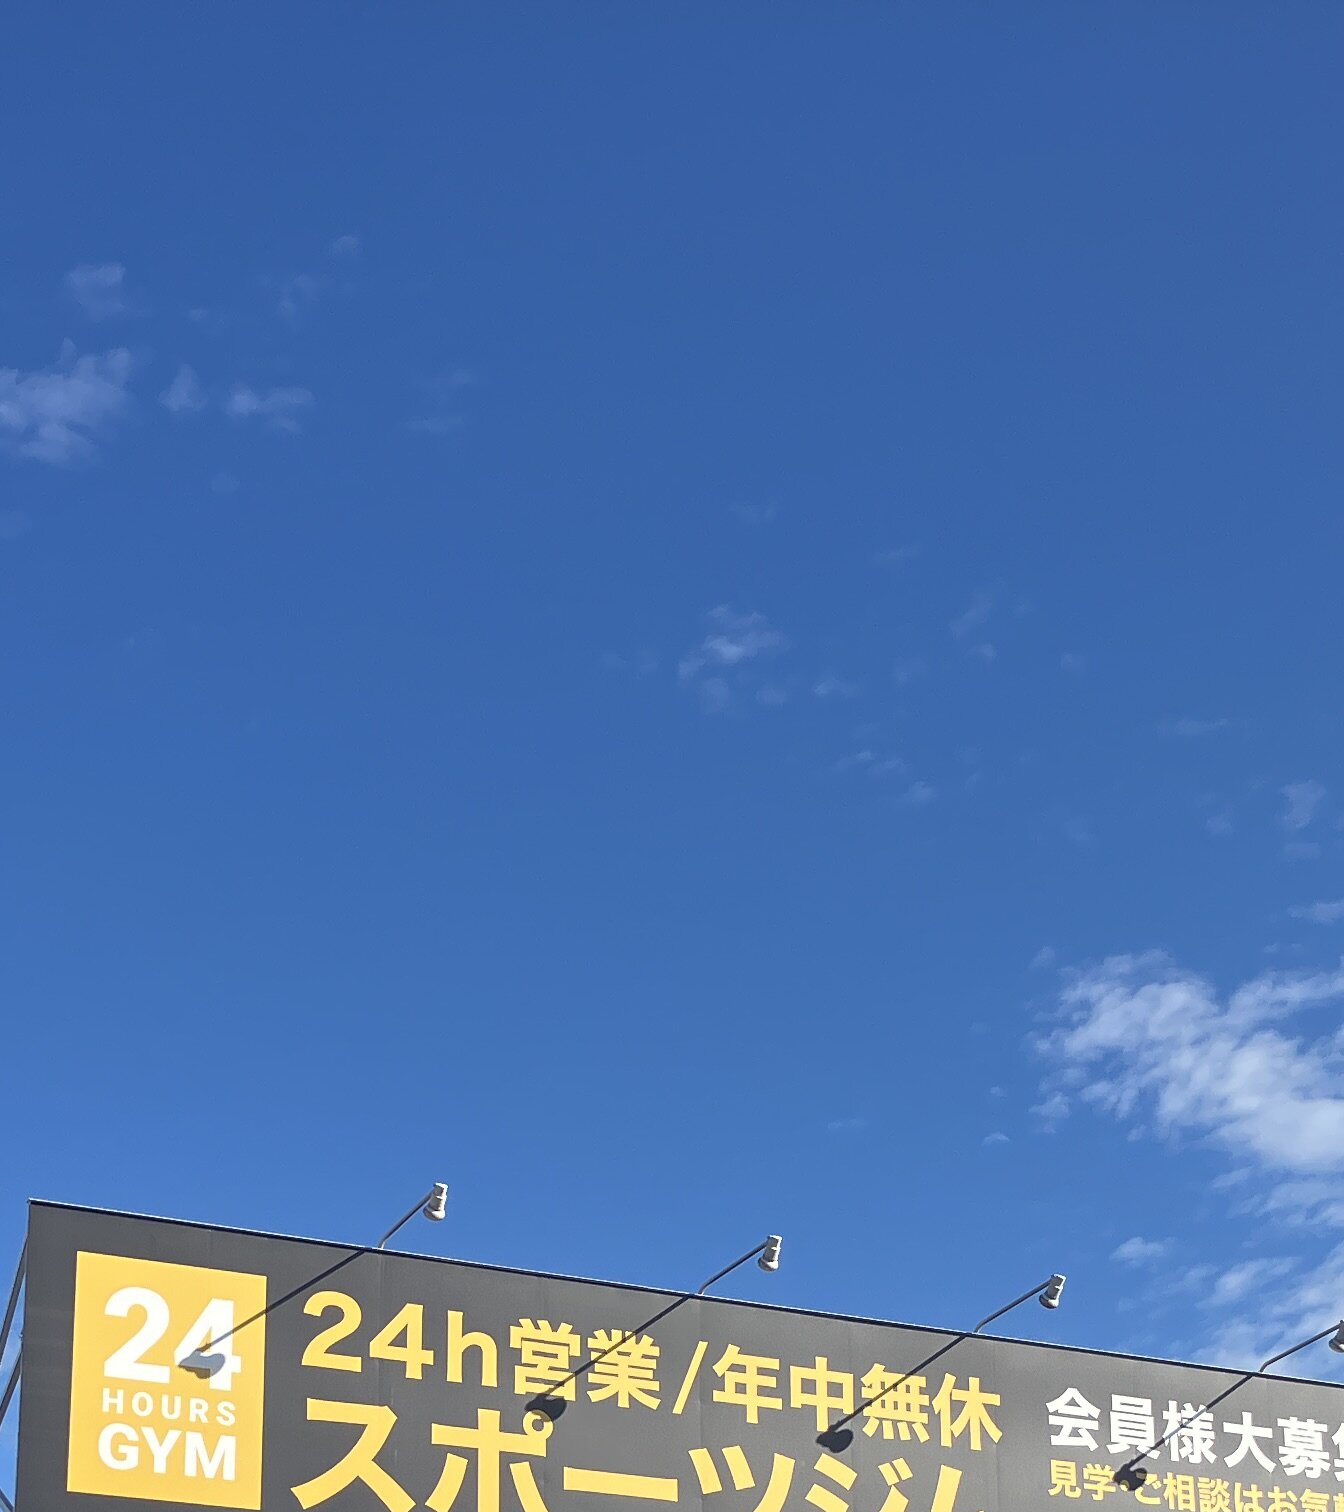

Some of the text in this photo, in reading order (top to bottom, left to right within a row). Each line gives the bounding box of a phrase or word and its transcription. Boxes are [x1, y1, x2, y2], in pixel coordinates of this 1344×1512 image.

[102, 1285, 242, 1391] 24
[301, 1290, 1003, 1453] 24h営業/年中無休
[102, 1388, 237, 1426] HOURS
[98, 1422, 237, 1481] GYM
